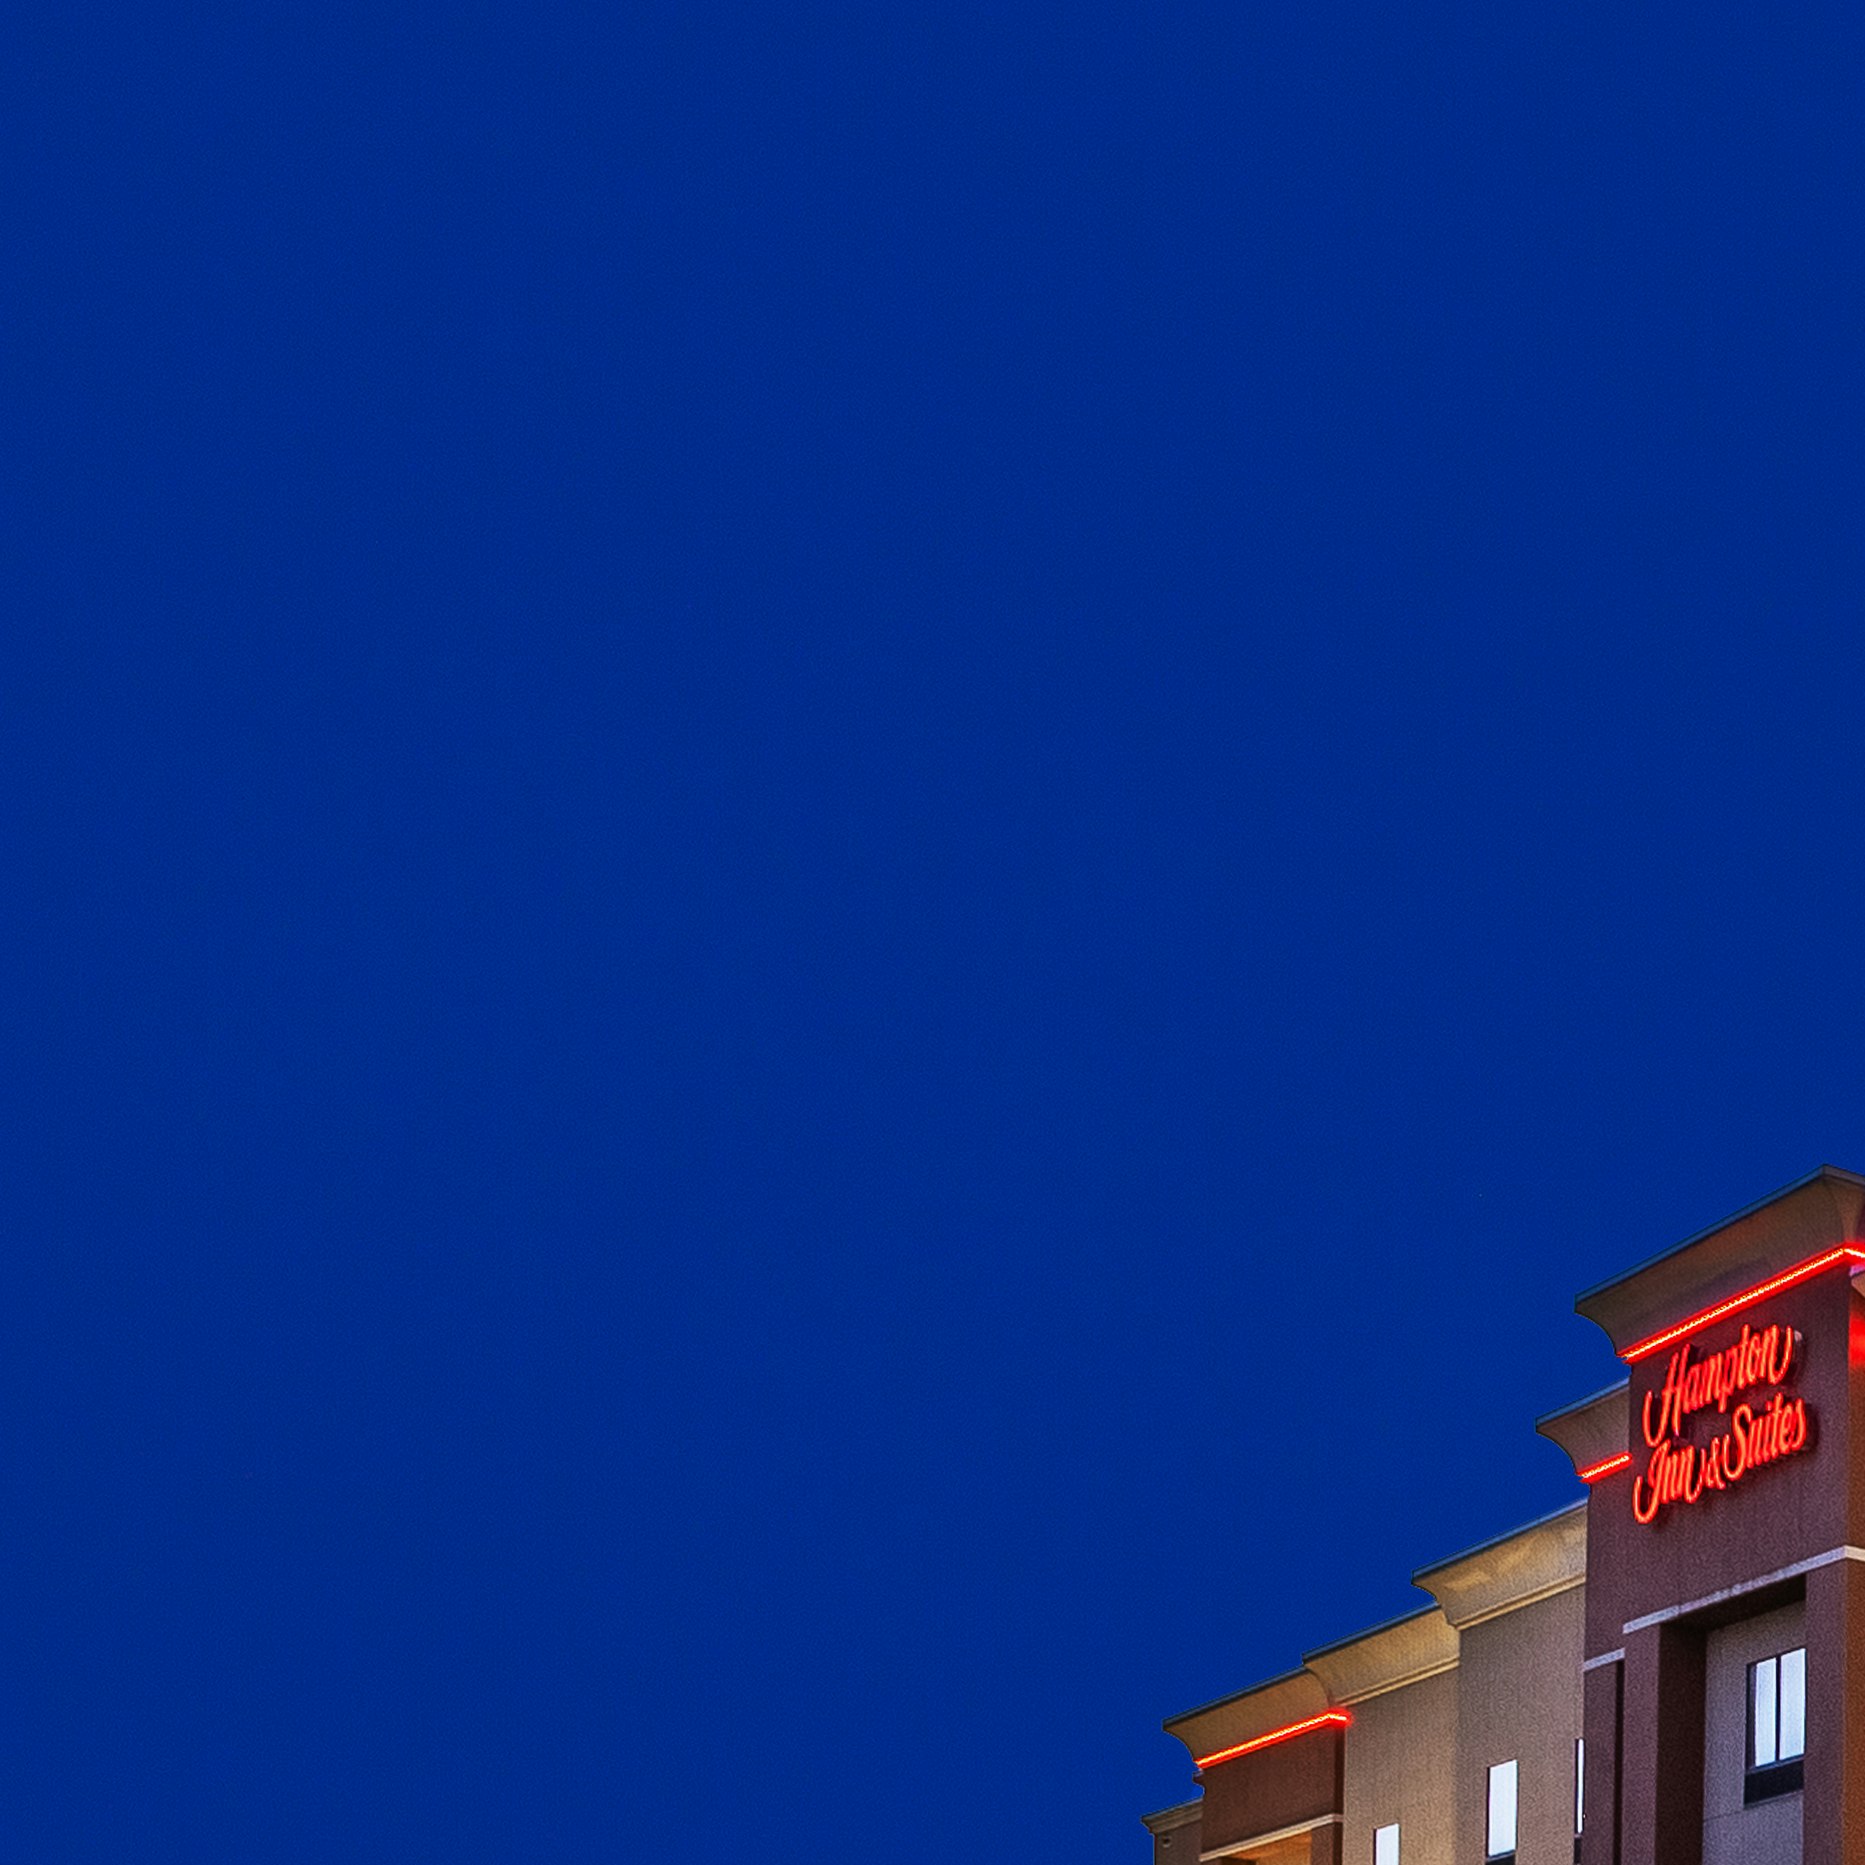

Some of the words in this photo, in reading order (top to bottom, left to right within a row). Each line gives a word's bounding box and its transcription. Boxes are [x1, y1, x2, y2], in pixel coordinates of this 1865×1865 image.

[1642, 1323, 1793, 1448] Hampton
[1633, 1438, 1705, 1524] Inn
[1721, 1391, 1807, 1482] Suites
